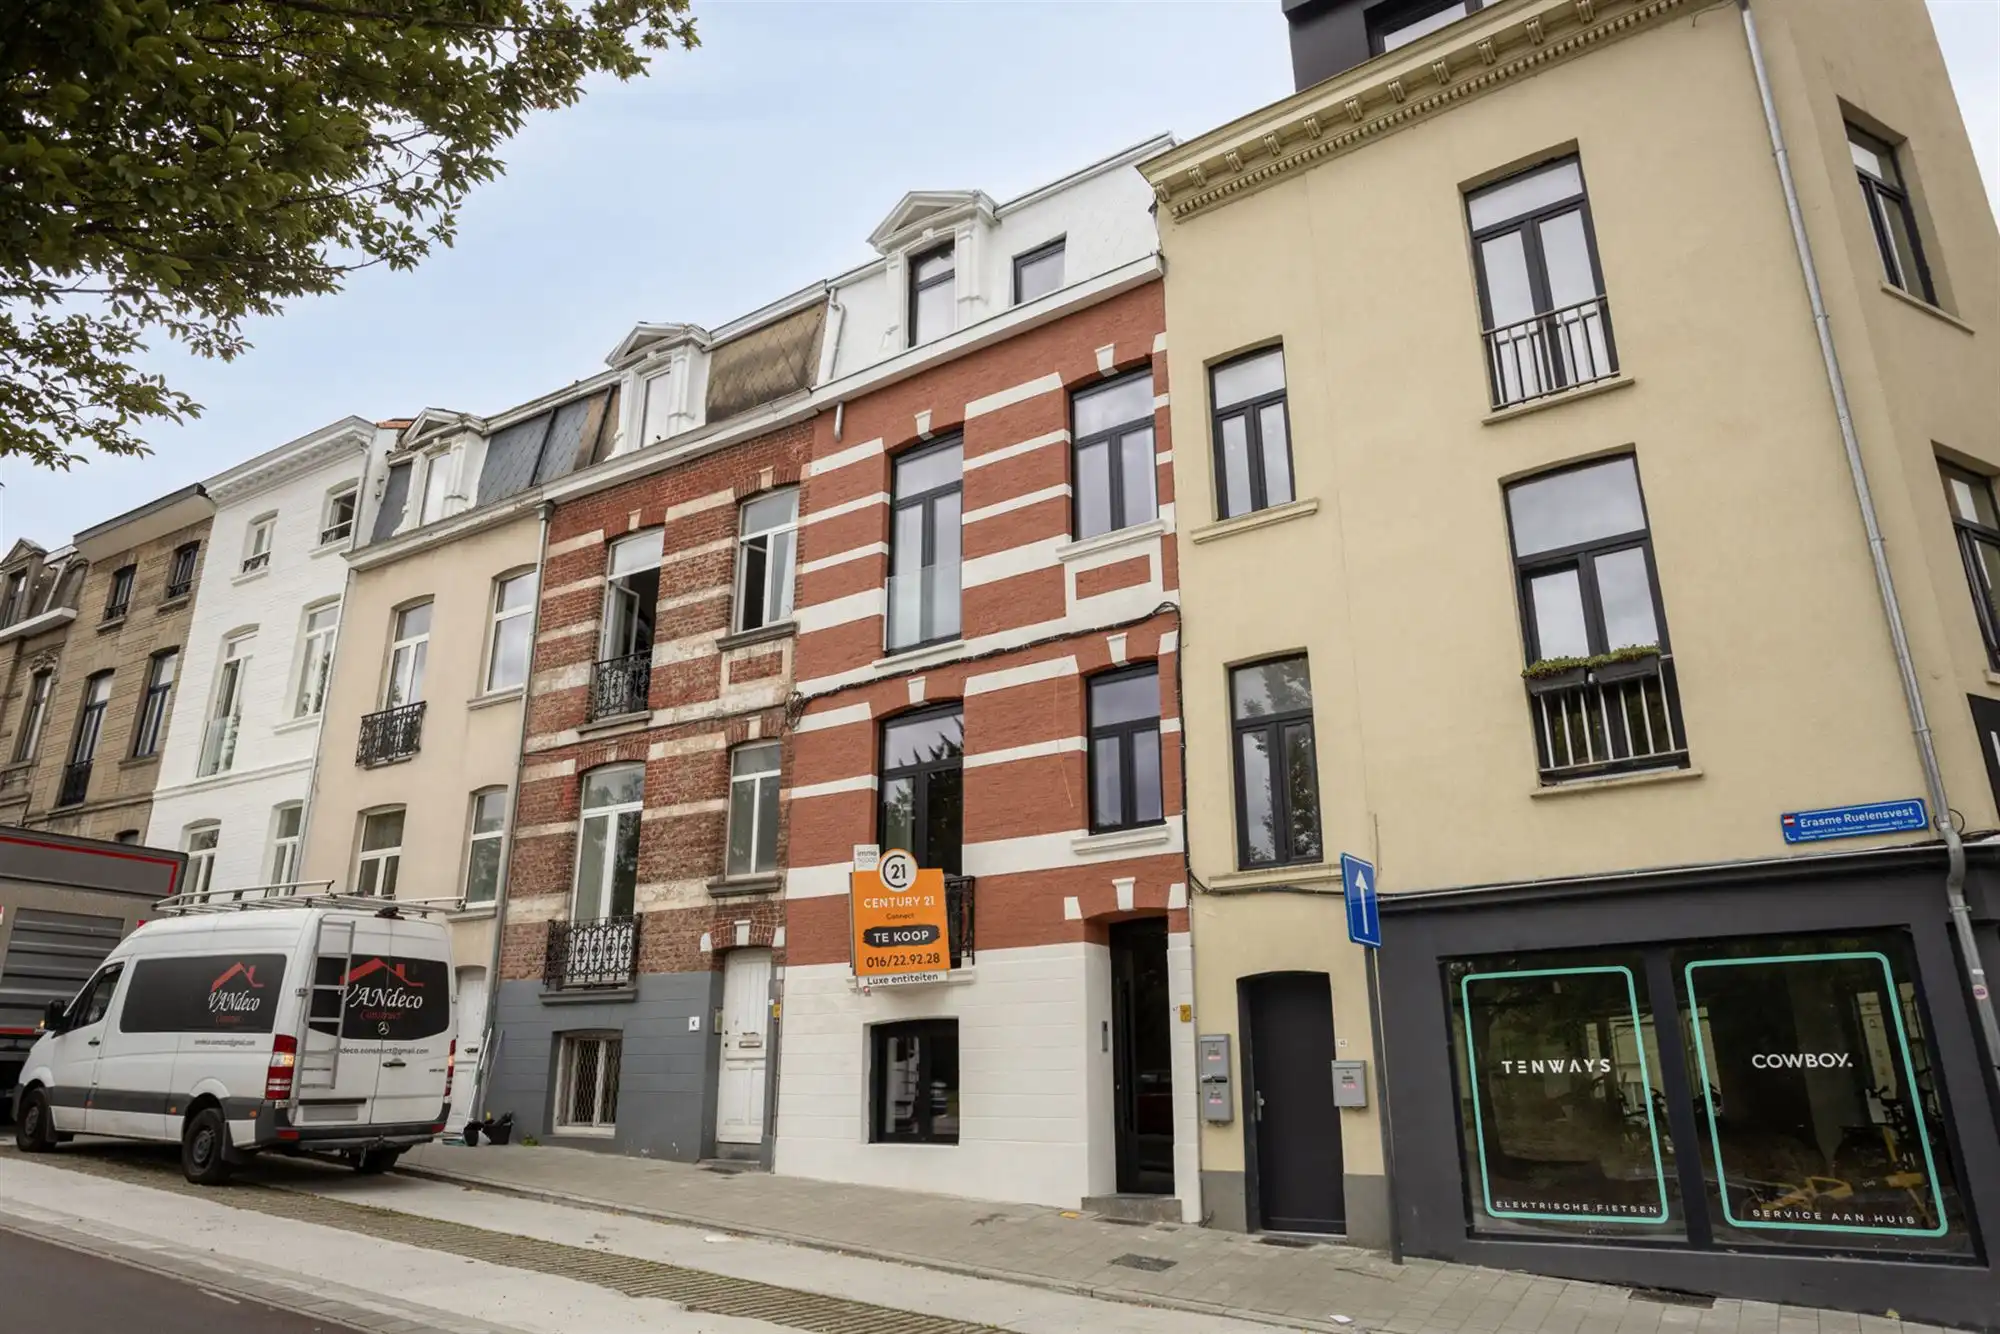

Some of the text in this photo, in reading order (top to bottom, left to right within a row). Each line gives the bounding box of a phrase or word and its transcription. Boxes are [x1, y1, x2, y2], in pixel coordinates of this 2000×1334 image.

[1800, 806, 1914, 828] Erasme Ruelensvest
[863, 895, 936, 909] CENTURY 21
[873, 930, 929, 943] TE KOOP
[866, 952, 941, 968] 016/22.92.28
[867, 972, 939, 986] Luxe entiteiten
[208, 989, 261, 1013] VANdeco
[1501, 1058, 1612, 1074] TENWAYS
[1496, 1200, 1658, 1214] ELEKTRISCHE FIETSEN
[1752, 1209, 1916, 1225] SERVICE AAN HUIS
